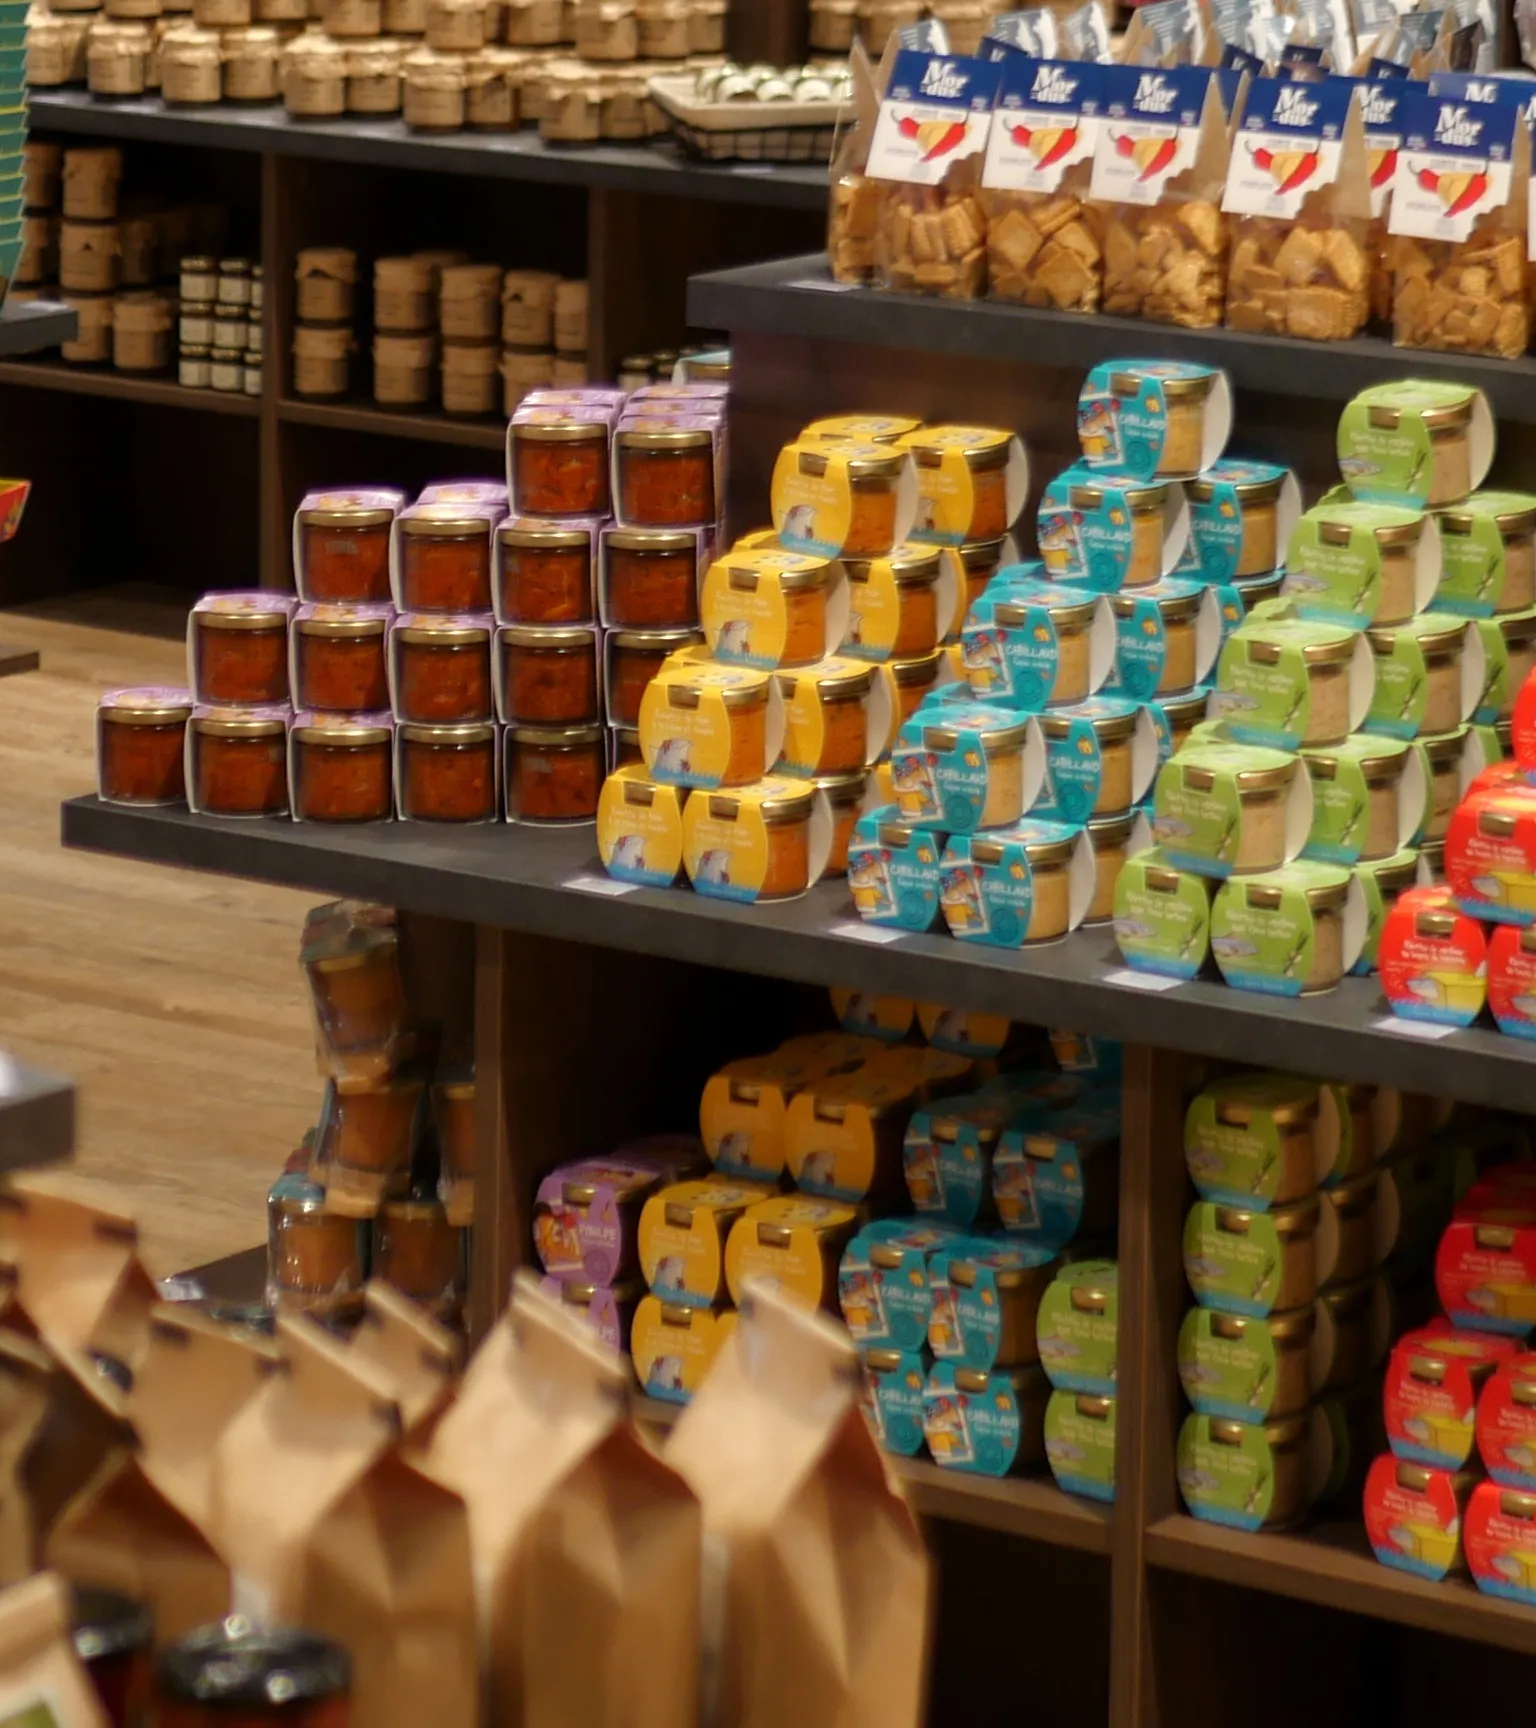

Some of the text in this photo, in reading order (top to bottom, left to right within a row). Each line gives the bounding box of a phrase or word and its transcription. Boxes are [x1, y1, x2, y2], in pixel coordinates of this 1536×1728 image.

[923, 60, 971, 89] Mor
[1035, 65, 1079, 94] Mor
[1136, 73, 1178, 104] Mor
[1275, 86, 1321, 116] Mor
[1437, 106, 1485, 135] Mor
